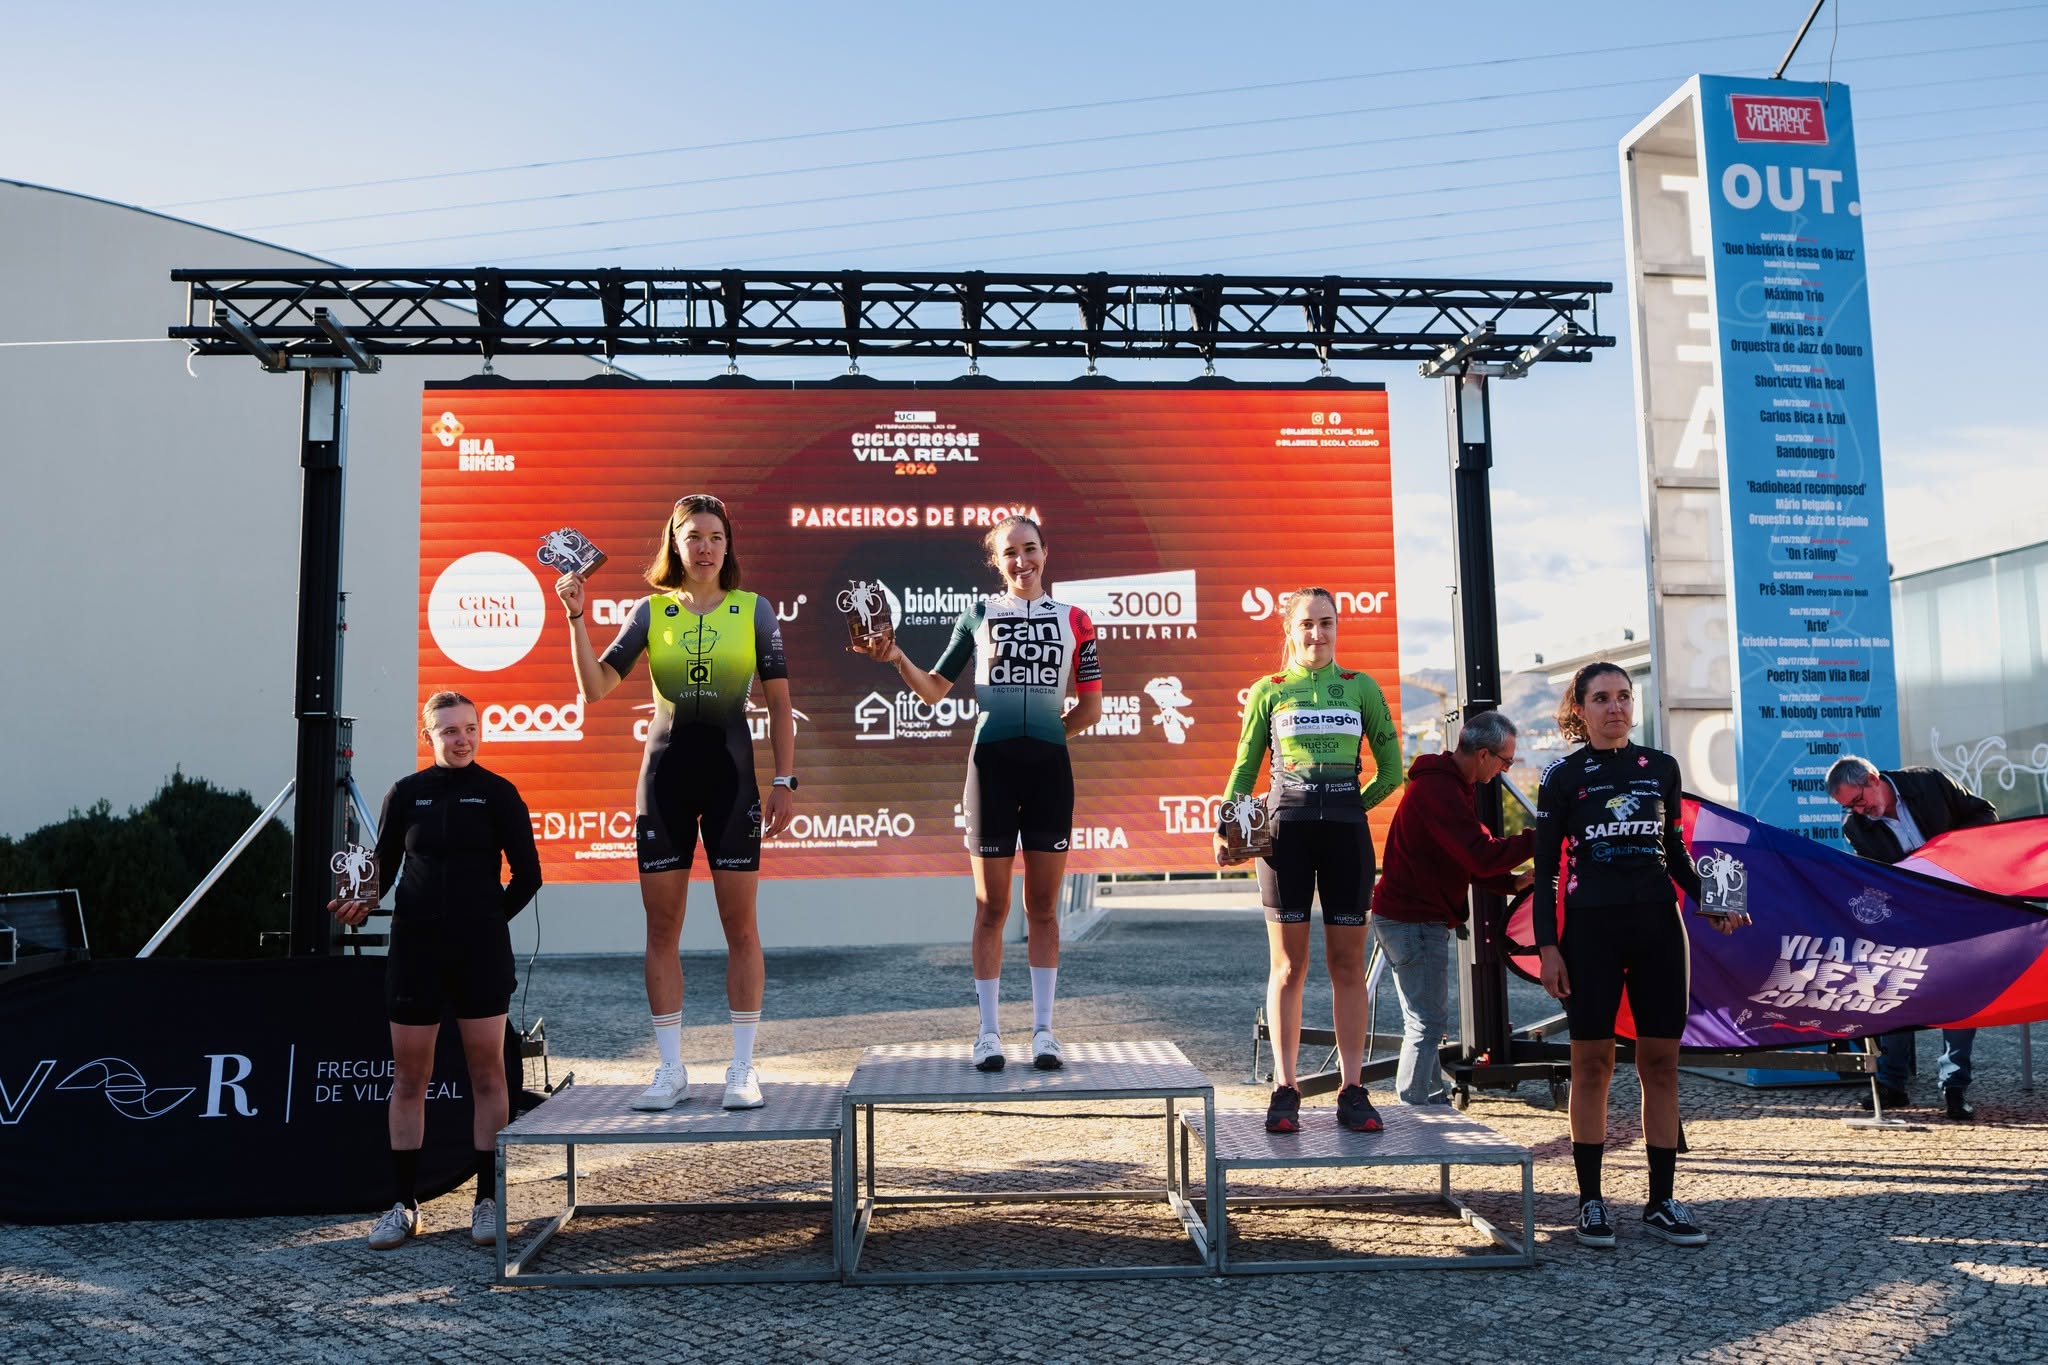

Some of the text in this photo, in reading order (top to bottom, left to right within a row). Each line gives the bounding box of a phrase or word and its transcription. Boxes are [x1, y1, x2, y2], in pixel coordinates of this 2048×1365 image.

[1722, 163, 1861, 216] OUT.
[1746, 243, 1784, 257] história
[1787, 244, 1794, 257] é
[1796, 247, 1819, 258] essa
[1822, 248, 1833, 259] do
[1764, 287, 1824, 302] Máximo Trio
[1770, 323, 1795, 335] Nikki
[1817, 326, 1824, 336] &
[1731, 339, 1863, 357] Orquestra de Jazz do Douro
[1755, 375, 1845, 390] Shortcutz Vila Real
[898, 413, 916, 421] UCI
[1760, 410, 1846, 425] Carlos Bica & Azul
[459, 438, 494, 455] BILA
[851, 432, 979, 447] CICLOCROSSE
[852, 448, 979, 461] VILA REAL
[1776, 445, 1835, 460] Bandonegro
[459, 455, 515, 471] BIKERS
[895, 462, 937, 475] 2026
[1747, 480, 1867, 496] 'Radiohead recomposed'
[1776, 498, 1800, 510] Mário
[1802, 499, 1835, 511] Delgado
[791, 507, 918, 527] PARCEIROS
[926, 507, 954, 527] DE
[1749, 513, 1869, 528] Orquestra de Jazz de Espinho
[1786, 547, 1838, 562] 'On Falling'
[1759, 582, 1804, 596] Pré-Slam
[1108, 591, 1182, 617] 3000
[905, 613, 936, 626] clean
[1804, 619, 1830, 633] 'Arte'
[991, 622, 1060, 641] can
[1097, 624, 1197, 640] BILIÁRIA
[1742, 636, 1778, 648] Cristóvão
[997, 641, 1062, 665] non
[690, 665, 709, 683] Q
[991, 660, 1058, 685] dale
[1767, 669, 1870, 683] Poetry Slam Vila Real
[895, 690, 979, 727] fifogu
[1758, 705, 1882, 720] 'Mr. Nobody contra Putin'
[482, 694, 584, 742] pood
[896, 720, 931, 729] Property
[896, 729, 952, 739] Management
[1806, 742, 1842, 755] 'Limbo'
[1585, 820, 1663, 841] SAERTEX
[1812, 827, 1839, 839] Norte
[1781, 935, 1928, 971] VILA REAL
[1760, 958, 1925, 1001] MEXE
[1748, 989, 1904, 1014] COMIGO
[317, 1061, 395, 1080] FREGUE
[198, 1054, 258, 1118] R
[315, 1085, 342, 1102] DE
[424, 1082, 463, 1100] EAL
